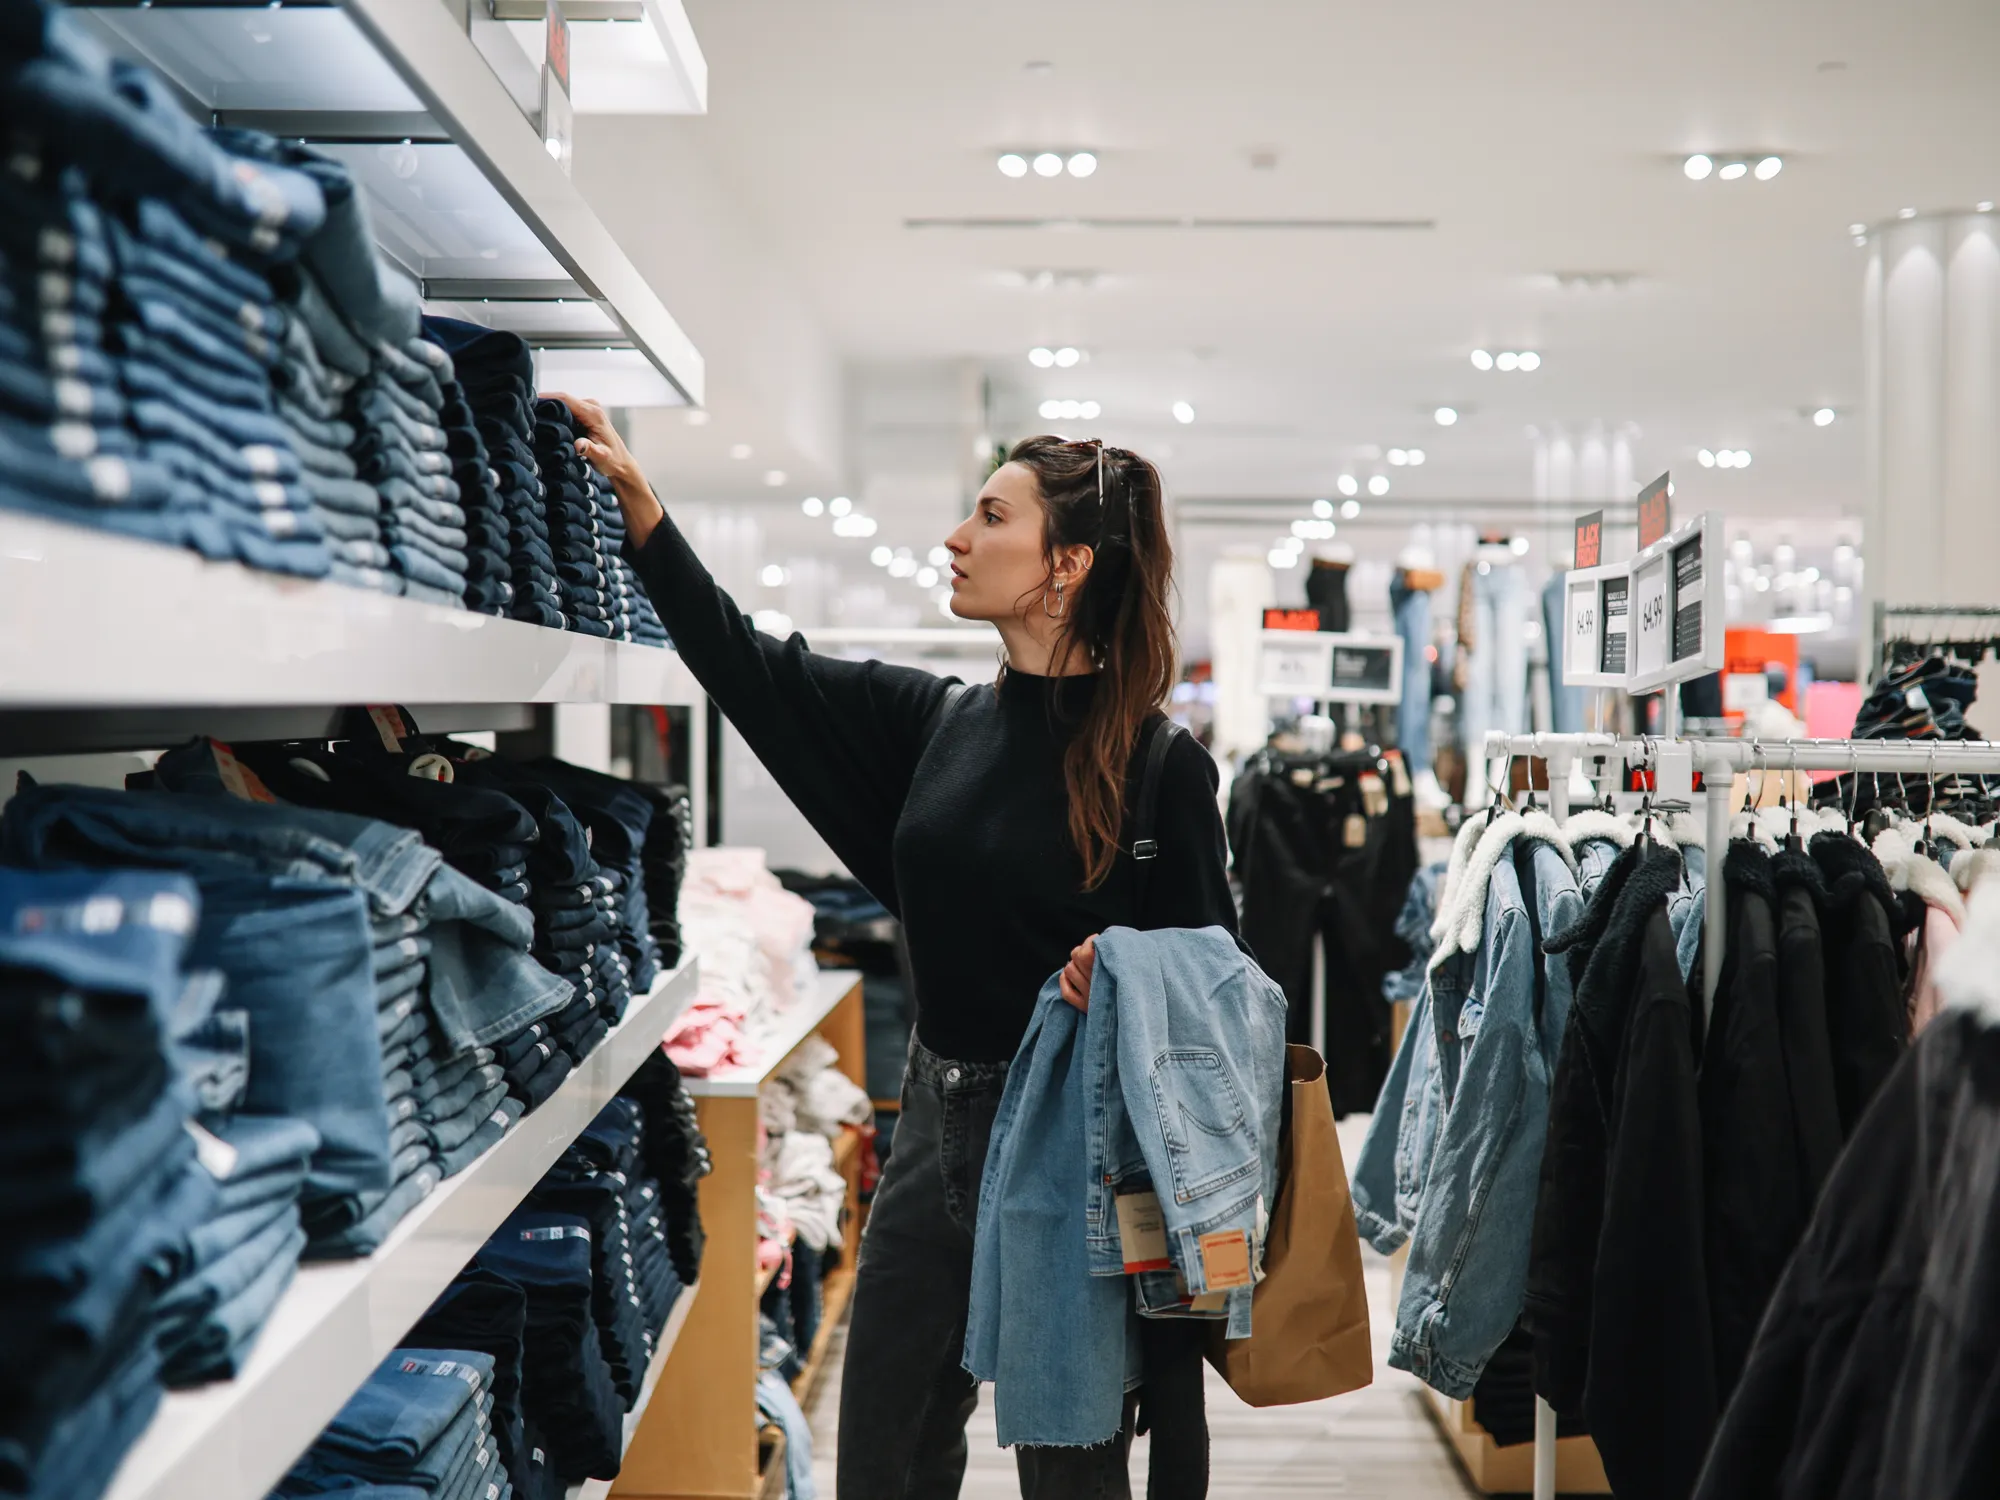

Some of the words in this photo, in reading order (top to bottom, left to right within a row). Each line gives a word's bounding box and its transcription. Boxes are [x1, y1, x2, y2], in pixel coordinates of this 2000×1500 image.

[1577, 522, 1600, 547] BLACK
[1575, 544, 1599, 569] FRIDAY
[1577, 609, 1593, 635] 64.99
[1643, 594, 1662, 632] 64.99
